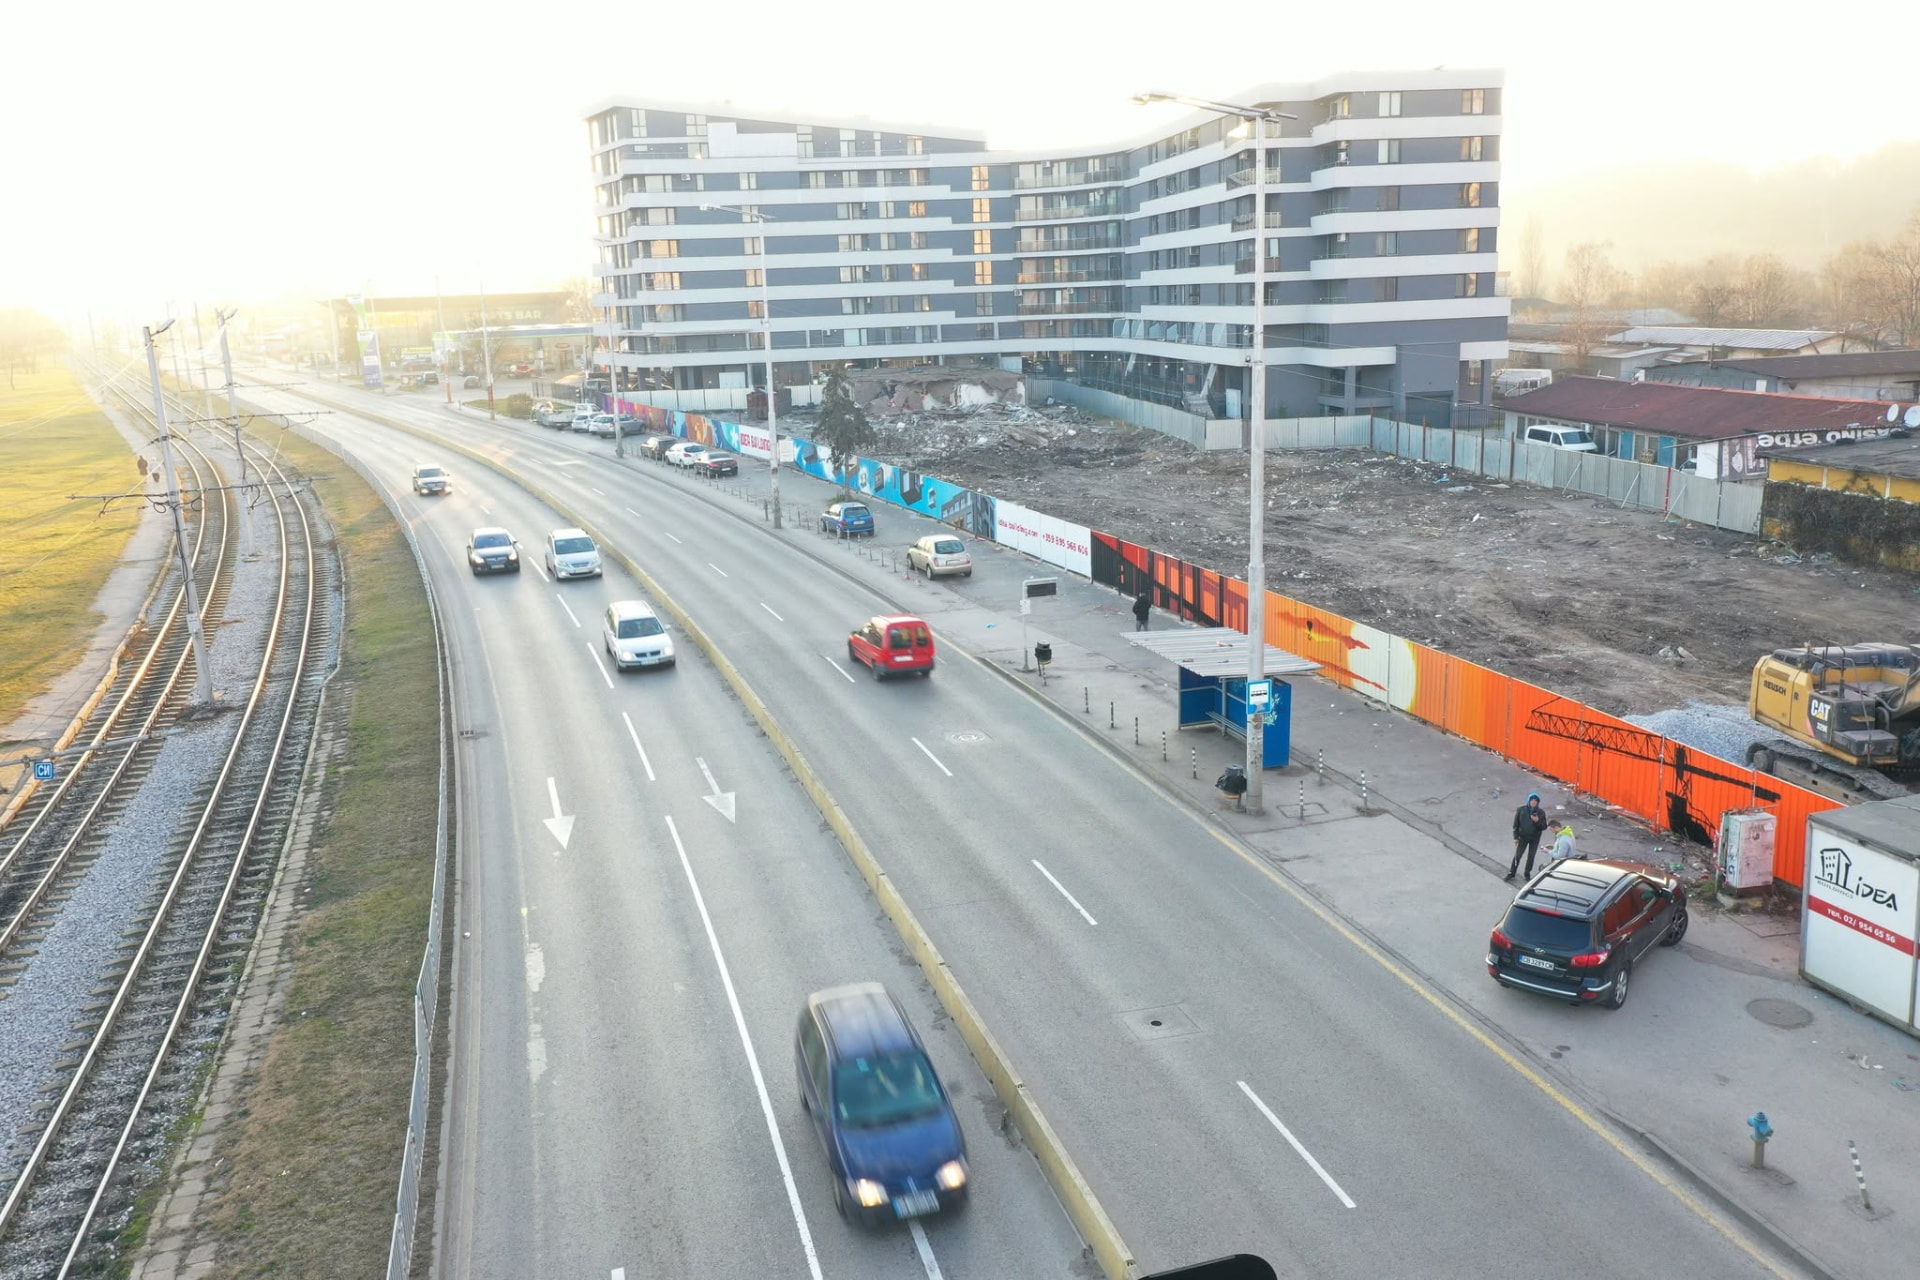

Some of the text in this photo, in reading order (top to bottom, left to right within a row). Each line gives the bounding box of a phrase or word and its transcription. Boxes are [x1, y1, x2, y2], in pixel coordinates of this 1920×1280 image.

[1811, 699, 1831, 721] CAT
[1858, 921, 1873, 933] 954
[1874, 928, 1885, 939] 65
[1885, 934, 1896, 944] 56
